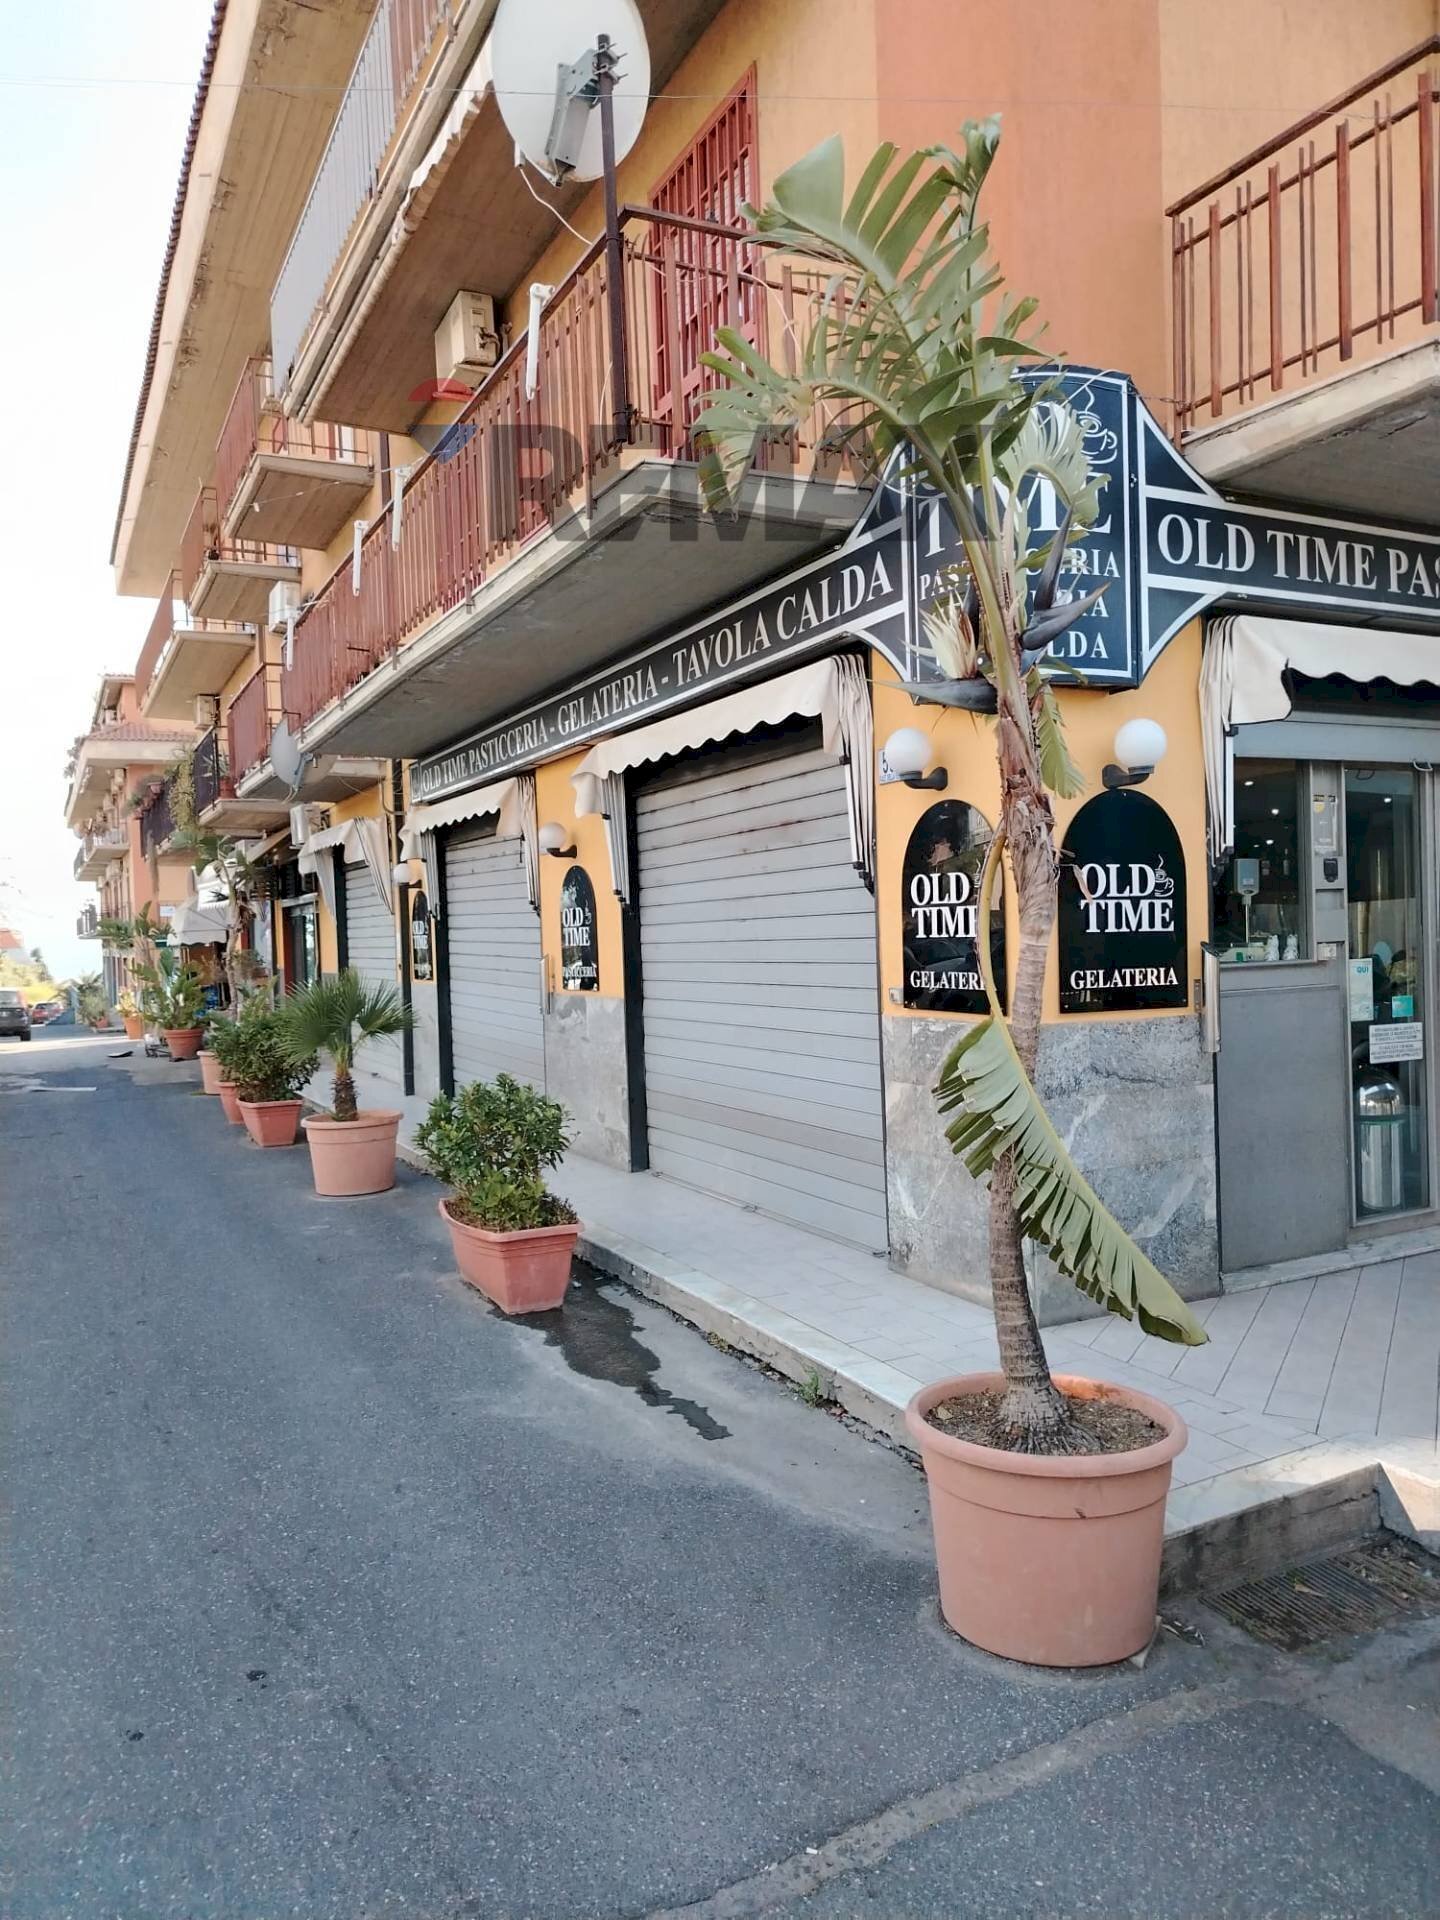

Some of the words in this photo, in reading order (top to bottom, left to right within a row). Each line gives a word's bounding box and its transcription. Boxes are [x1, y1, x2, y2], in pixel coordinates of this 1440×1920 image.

[1157, 513, 1256, 573] OLD
[1266, 529, 1377, 590] TIME
[1386, 547, 1440, 599] PA
[422, 763, 442, 793] OLD
[441, 752, 468, 785] TIME
[468, 716, 549, 775] PASTICCERIA
[557, 663, 659, 736] GELATERIA
[672, 611, 771, 688] TAVOLA
[776, 551, 894, 641] CALDA
[910, 872, 970, 906] OLD
[1081, 863, 1156, 899] OLD
[562, 907, 584, 927] OLD
[1080, 899, 1175, 933] TIME
[562, 926, 591, 947] TIME
[1070, 966, 1179, 990] GELATERIA
